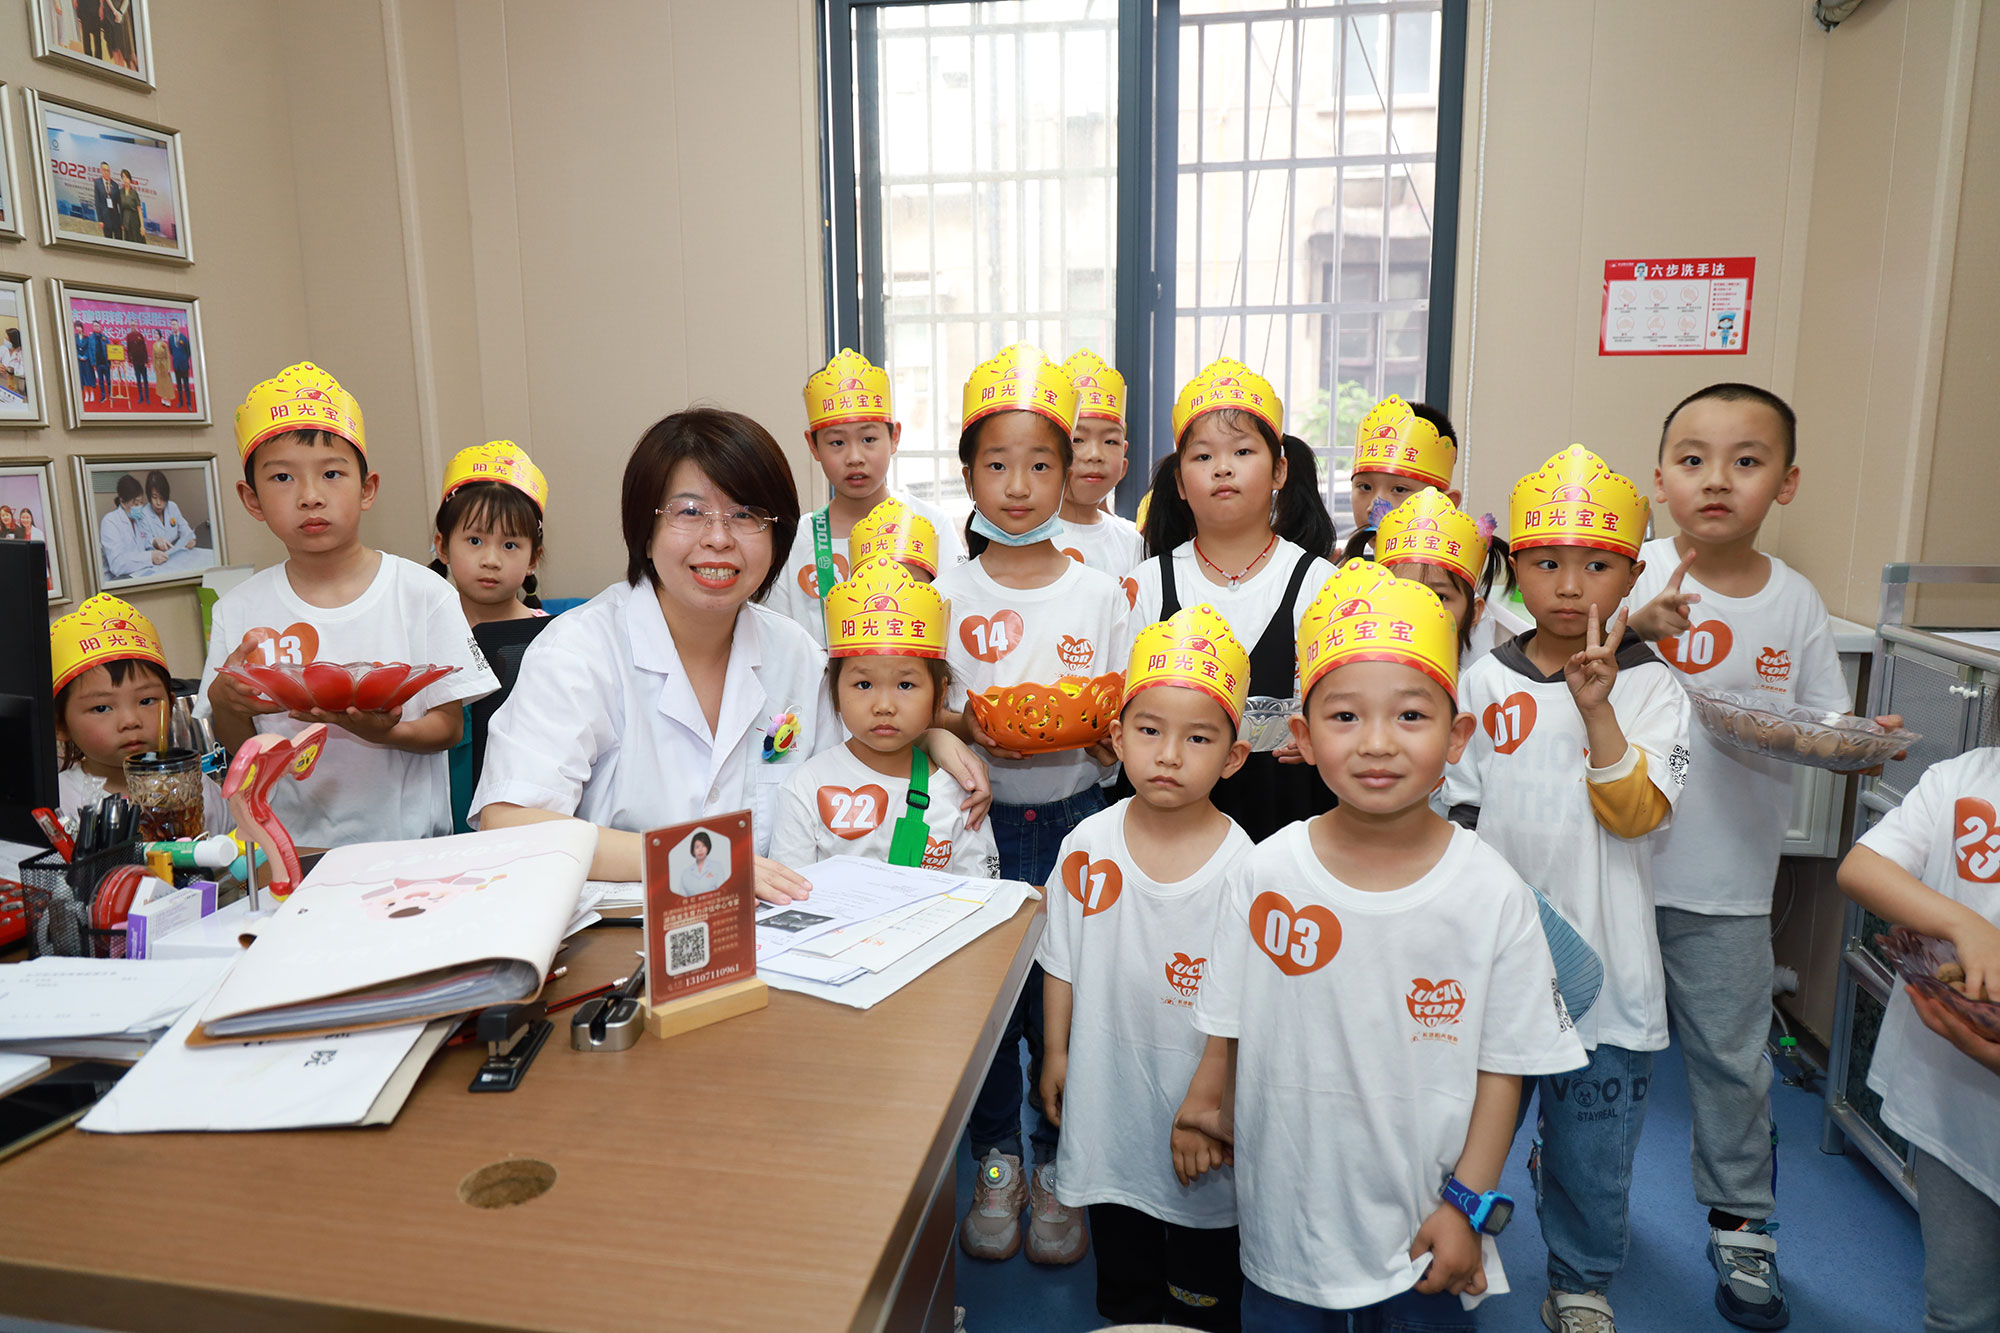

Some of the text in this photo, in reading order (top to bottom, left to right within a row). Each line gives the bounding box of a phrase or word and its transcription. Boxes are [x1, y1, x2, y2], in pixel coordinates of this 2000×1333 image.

[51, 159, 87, 179] 2022
[1651, 263, 1726, 277] 六步洗手法
[822, 394, 884, 413] 阳光宝宝
[982, 383, 1059, 407] 阳光宝宝
[1191, 389, 1264, 411] 阳光宝宝
[270, 403, 358, 434] 阳光宝宝
[1525, 508, 1620, 532] 阳光宝宝
[861, 538, 925, 557] 阳光宝宝
[1385, 534, 1462, 558] 阳光宝宝
[842, 618, 928, 638] 阳光宝宝
[971, 621, 1009, 655] 14
[258, 635, 303, 666] 13
[1306, 620, 1415, 668] 阳光宝宝
[1673, 630, 1715, 665] 10
[1063, 652, 1091, 663] FOR
[1148, 654, 1237, 695] 阳光宝宝
[1760, 665, 1789, 675] FOR
[830, 793, 876, 829] 22
[1956, 816, 2000, 879] 23
[1265, 909, 1321, 967] 03
[685, 963, 740, 987] 13107110961
[1172, 974, 1199, 987] FO
[1414, 1002, 1460, 1016] FOR
[1577, 1108, 1618, 1122] STAYREAL
